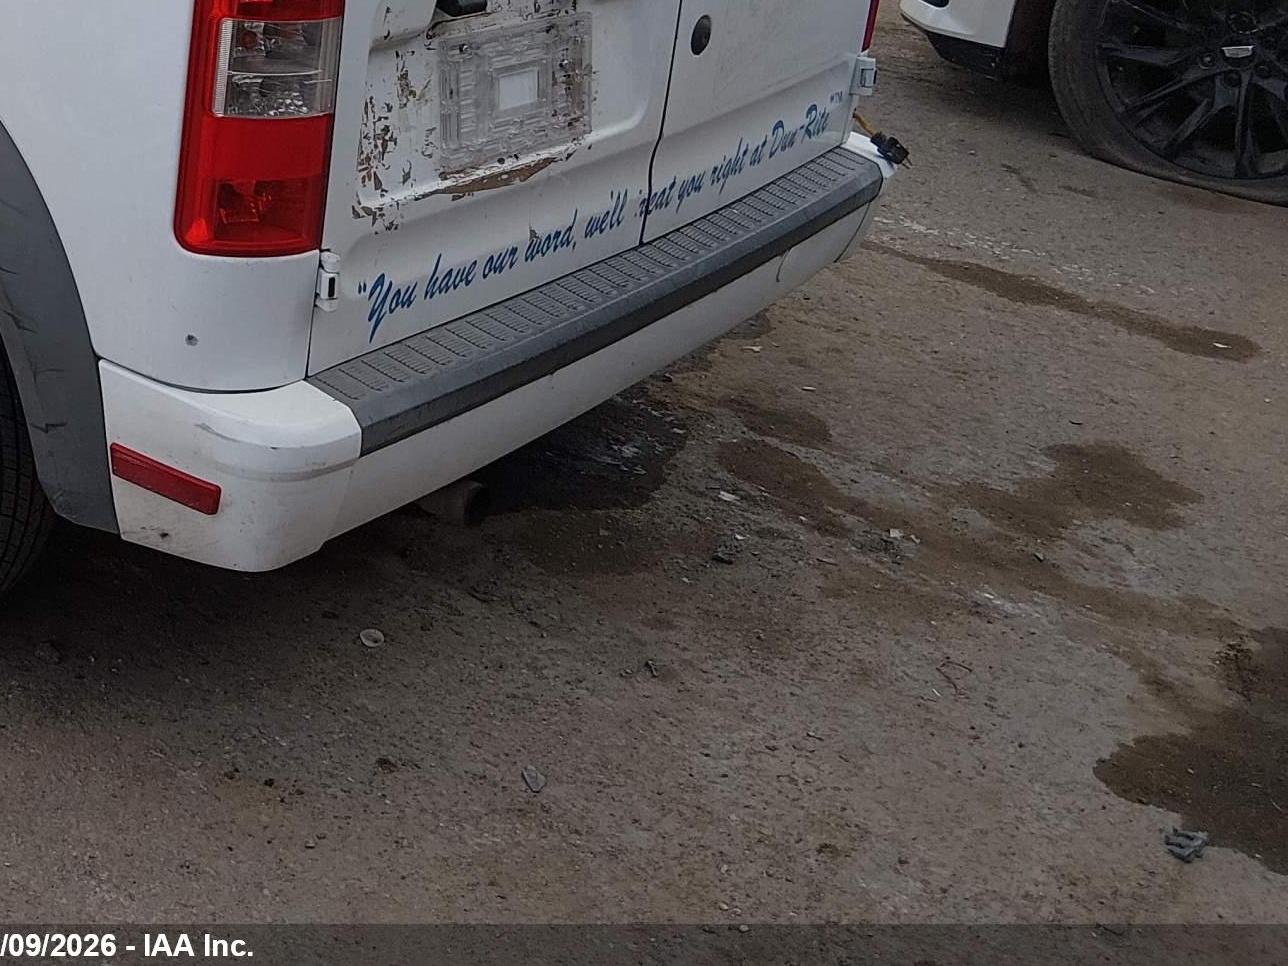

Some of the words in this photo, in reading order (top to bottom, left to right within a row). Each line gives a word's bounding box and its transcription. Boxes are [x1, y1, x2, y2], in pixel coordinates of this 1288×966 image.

[424, 253, 478, 300] have
[483, 247, 519, 280] our
[525, 208, 578, 251] word,
[676, 170, 706, 214] you
[710, 138, 749, 194] right
[749, 134, 768, 167] at
